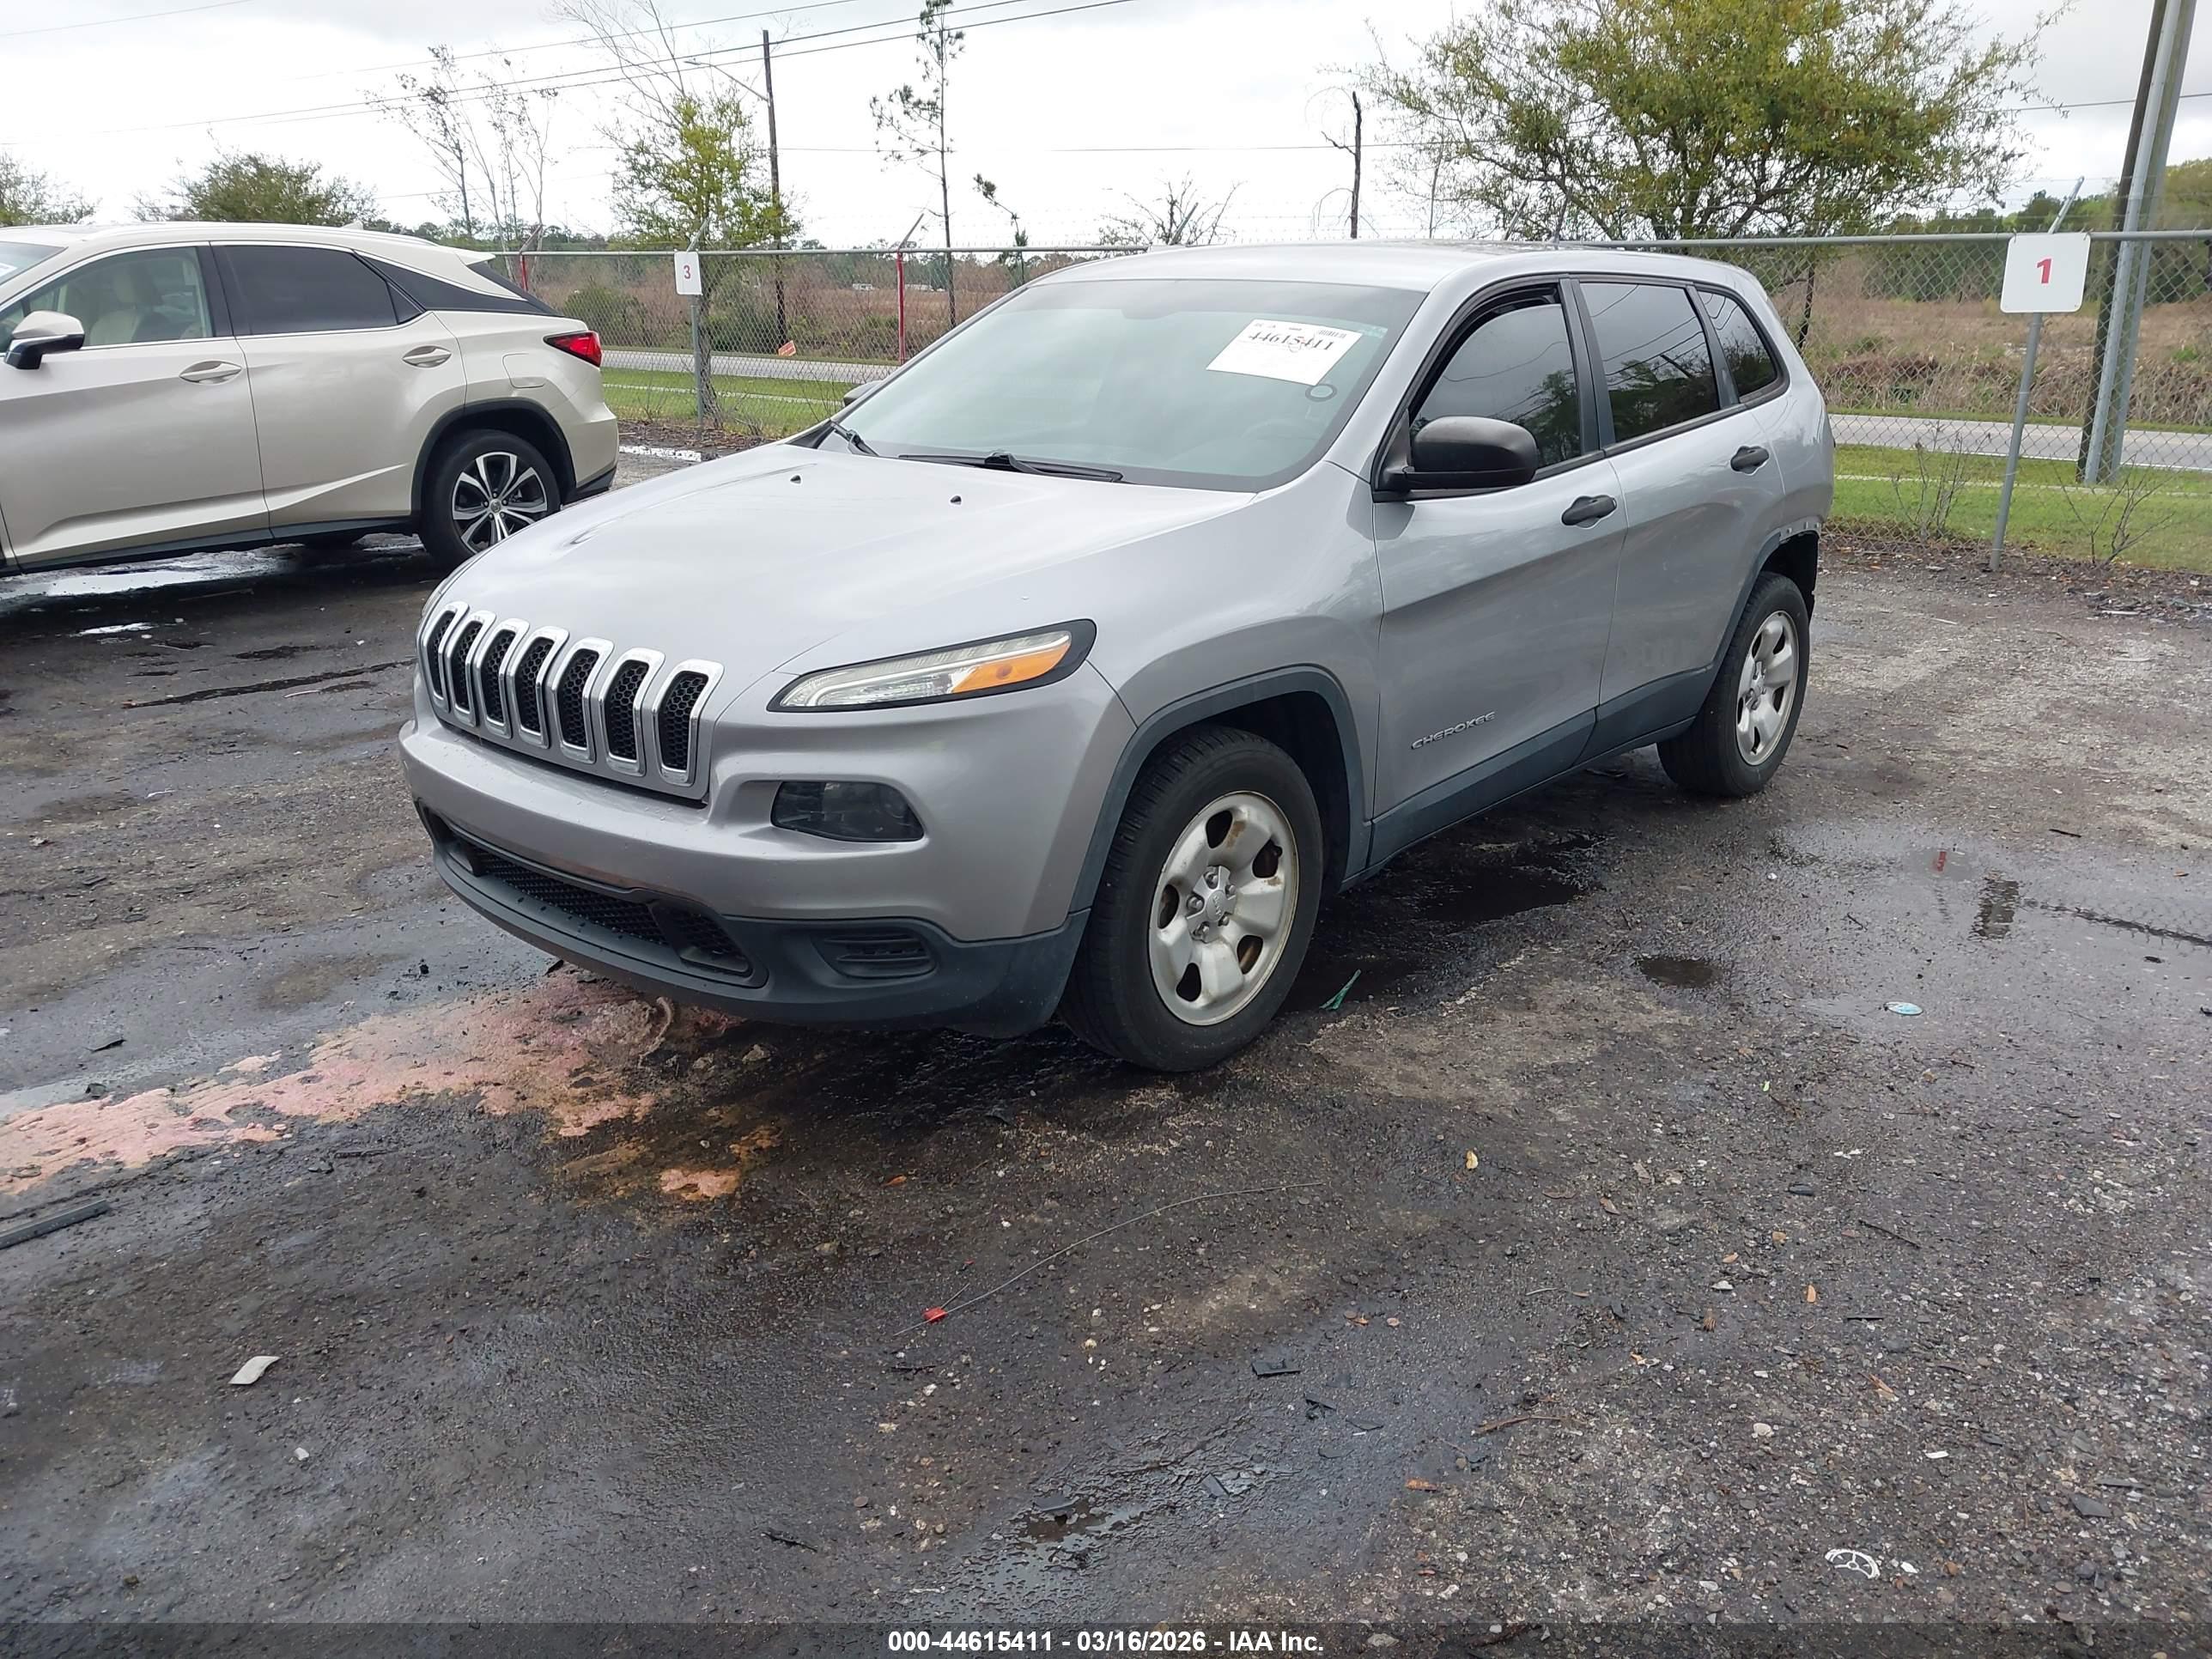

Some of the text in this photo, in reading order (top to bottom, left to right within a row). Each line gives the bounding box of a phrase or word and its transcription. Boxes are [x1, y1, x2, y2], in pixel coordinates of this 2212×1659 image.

[683, 264, 691, 280] 3
[2036, 258, 2052, 284] 1
[1248, 331, 1334, 351] 44615411
[1411, 711, 1495, 750] CHEROKEE
